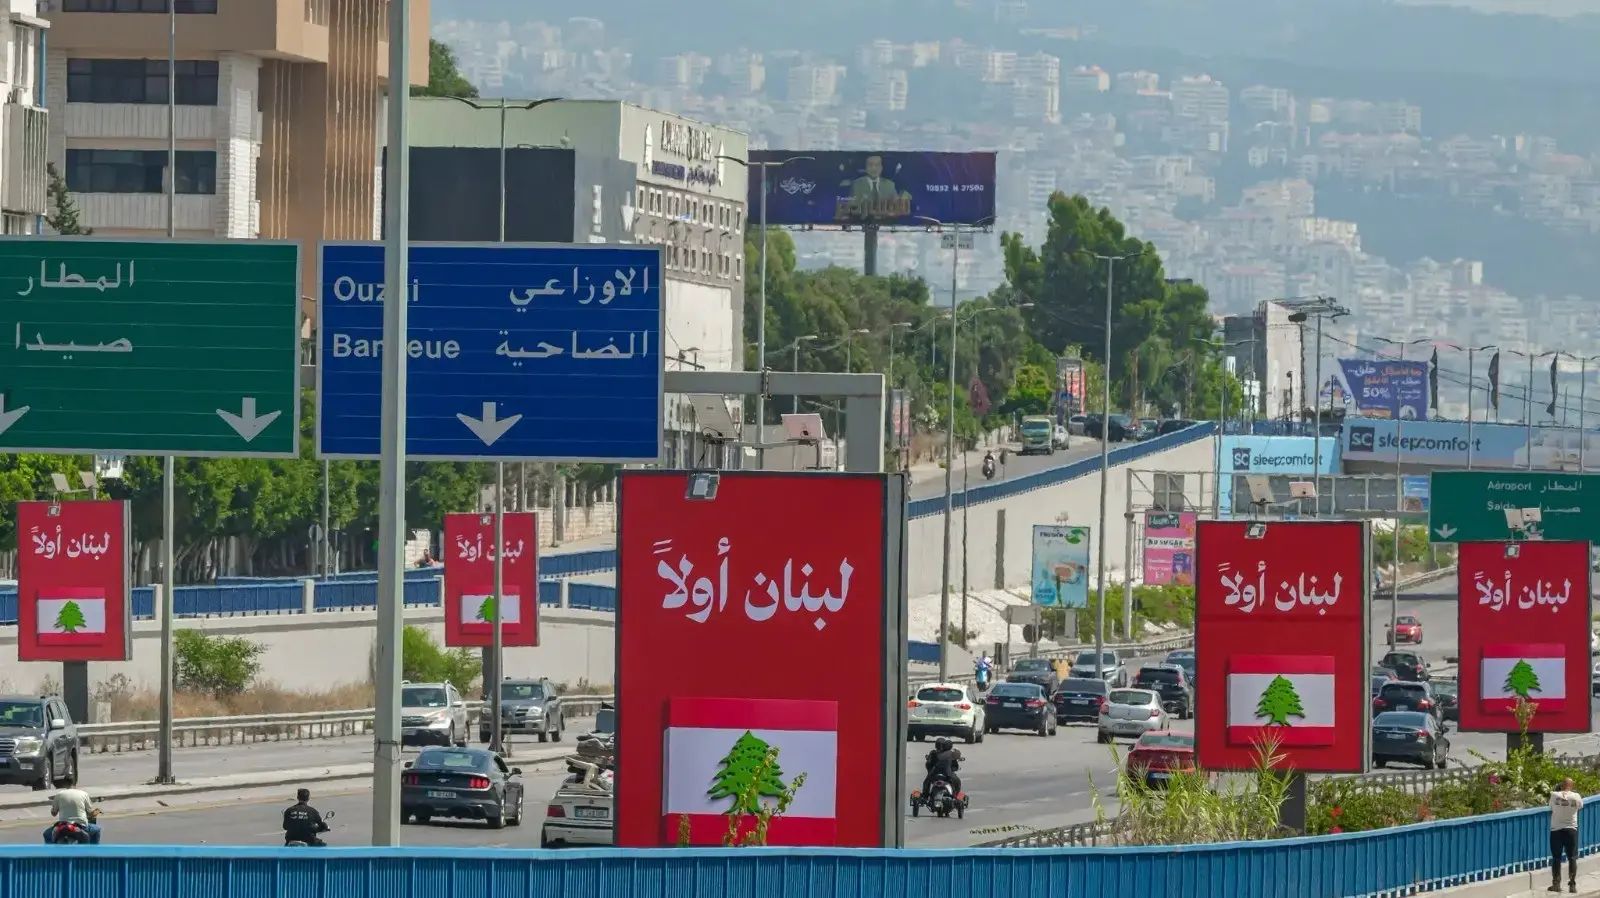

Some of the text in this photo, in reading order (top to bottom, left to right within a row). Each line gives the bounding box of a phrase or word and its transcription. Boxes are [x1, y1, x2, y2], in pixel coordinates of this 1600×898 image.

[16, 260, 135, 296] المطار
[333, 276, 419, 302] Ouzi
[509, 266, 649, 313] الاوزاعي
[15, 322, 133, 360] صيدا
[495, 330, 648, 367] الضاحية
[1351, 433, 1373, 447] SC
[1234, 452, 1323, 467] SC sleepcomfot
[1539, 479, 1582, 493] المطار
[30, 524, 111, 562] لبنان أولاً
[456, 533, 483, 562] أولاً
[653, 537, 854, 631] لبنان أولاً
[1218, 560, 1266, 613] أولاً
[1274, 571, 1343, 615] لبنان
[1474, 570, 1572, 613] لبنان أولاً
